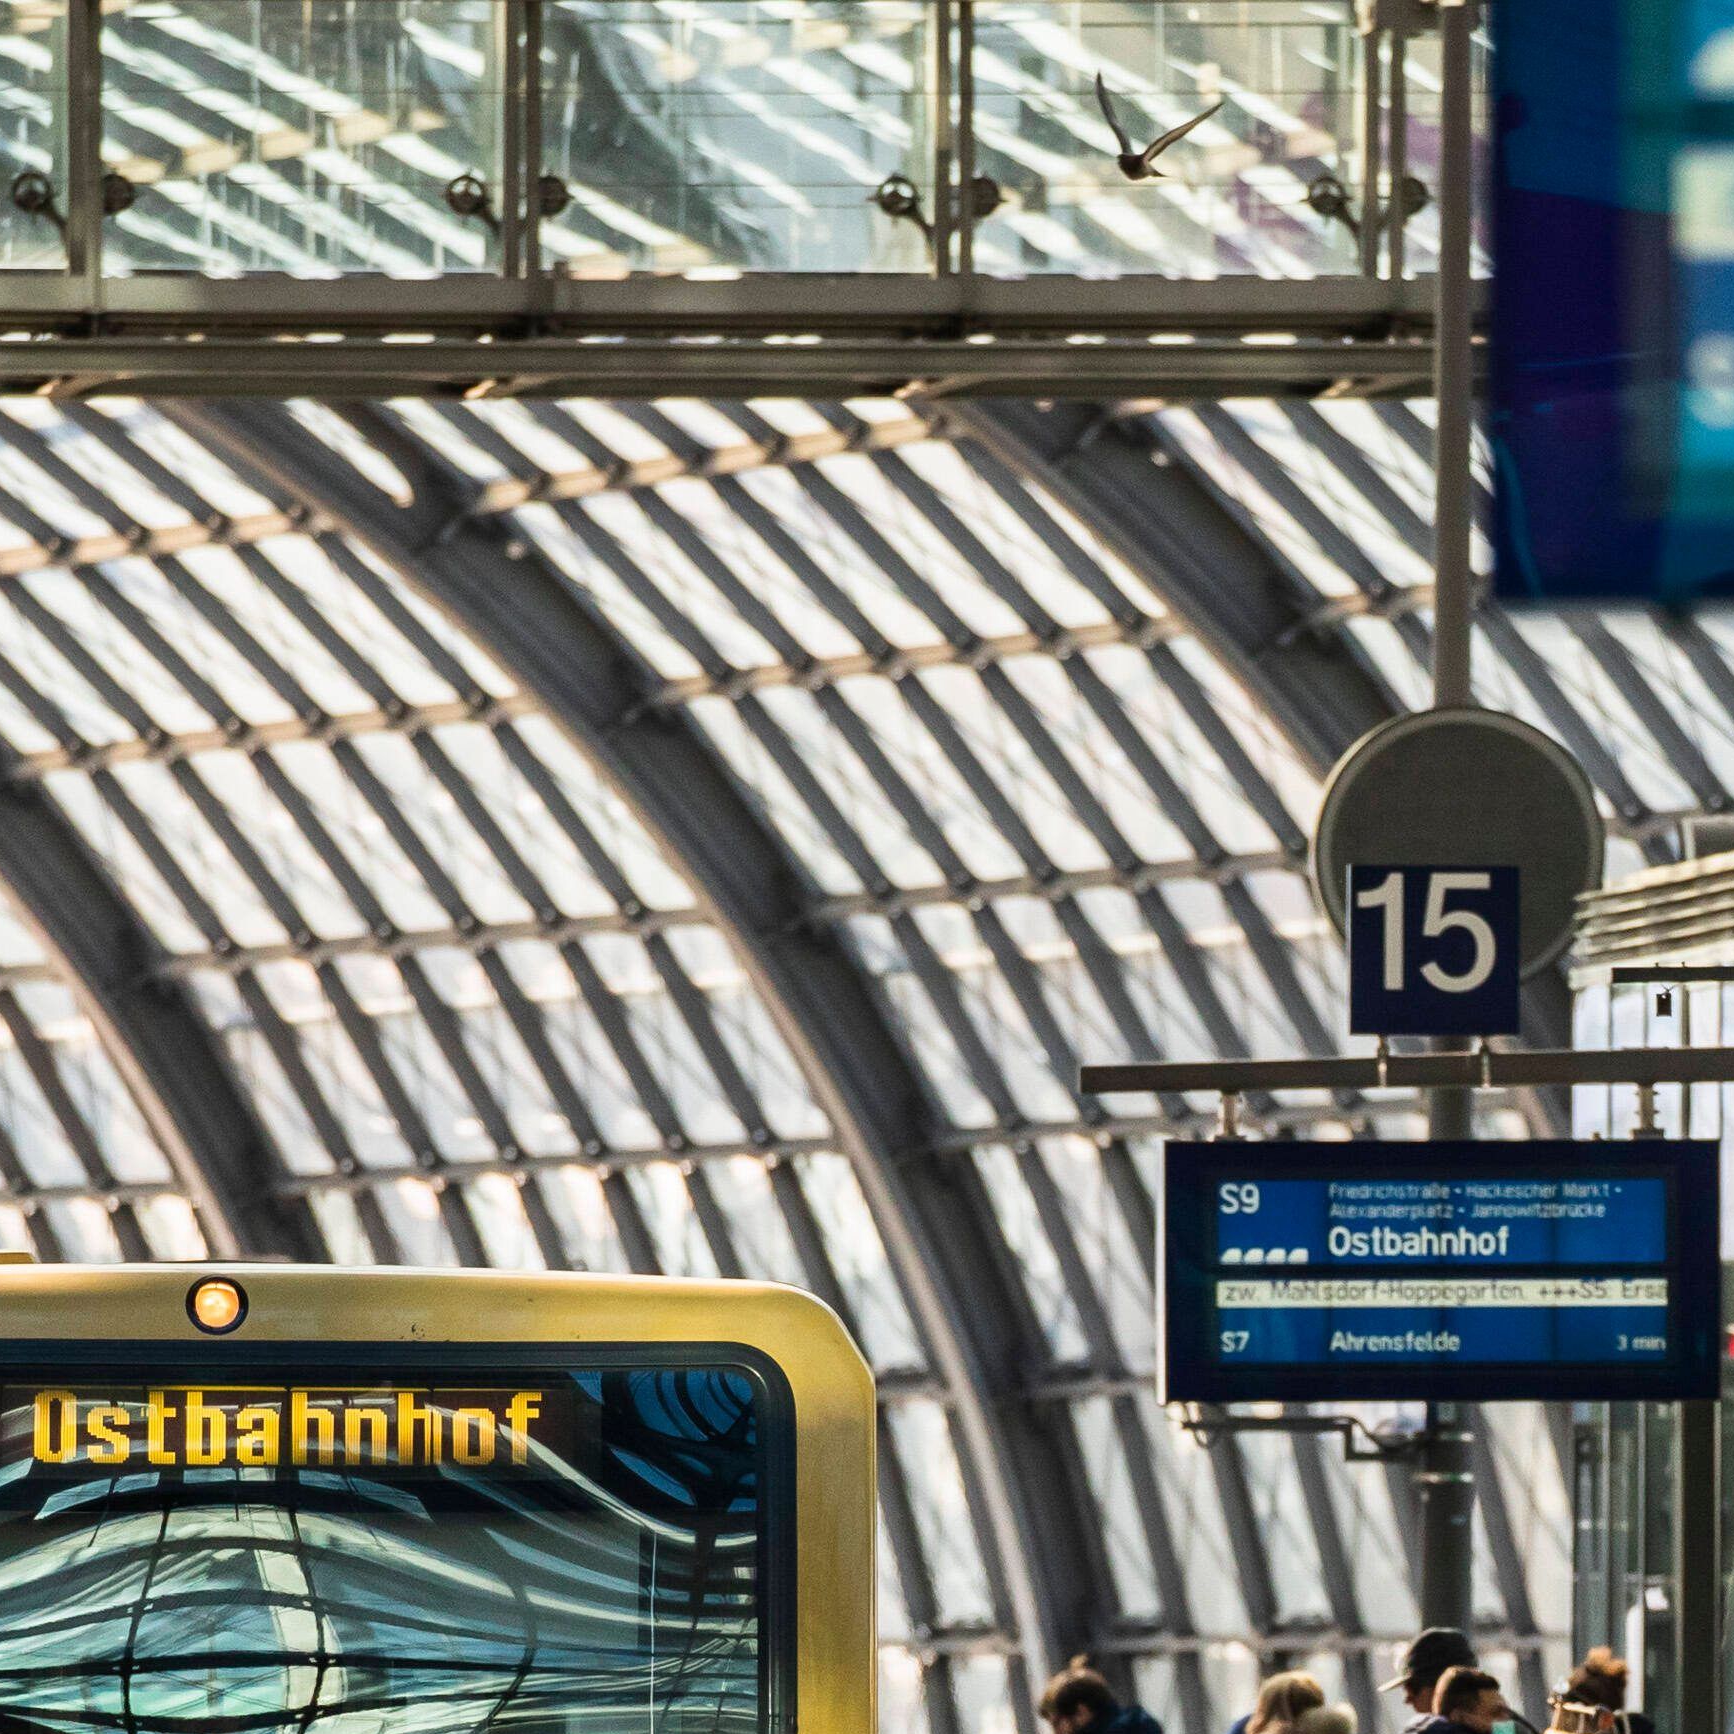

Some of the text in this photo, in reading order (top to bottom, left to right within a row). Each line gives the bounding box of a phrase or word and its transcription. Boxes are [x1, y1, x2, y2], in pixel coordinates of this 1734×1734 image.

[1357, 872, 1496, 993] 15
[1219, 1184, 1260, 1213] S9
[1328, 1225, 1510, 1256] Ostbahnhof
[1220, 1331, 1249, 1352] S7
[1330, 1331, 1461, 1352] Ahrensfelde
[32, 1390, 542, 1466] Ostbahnhof
